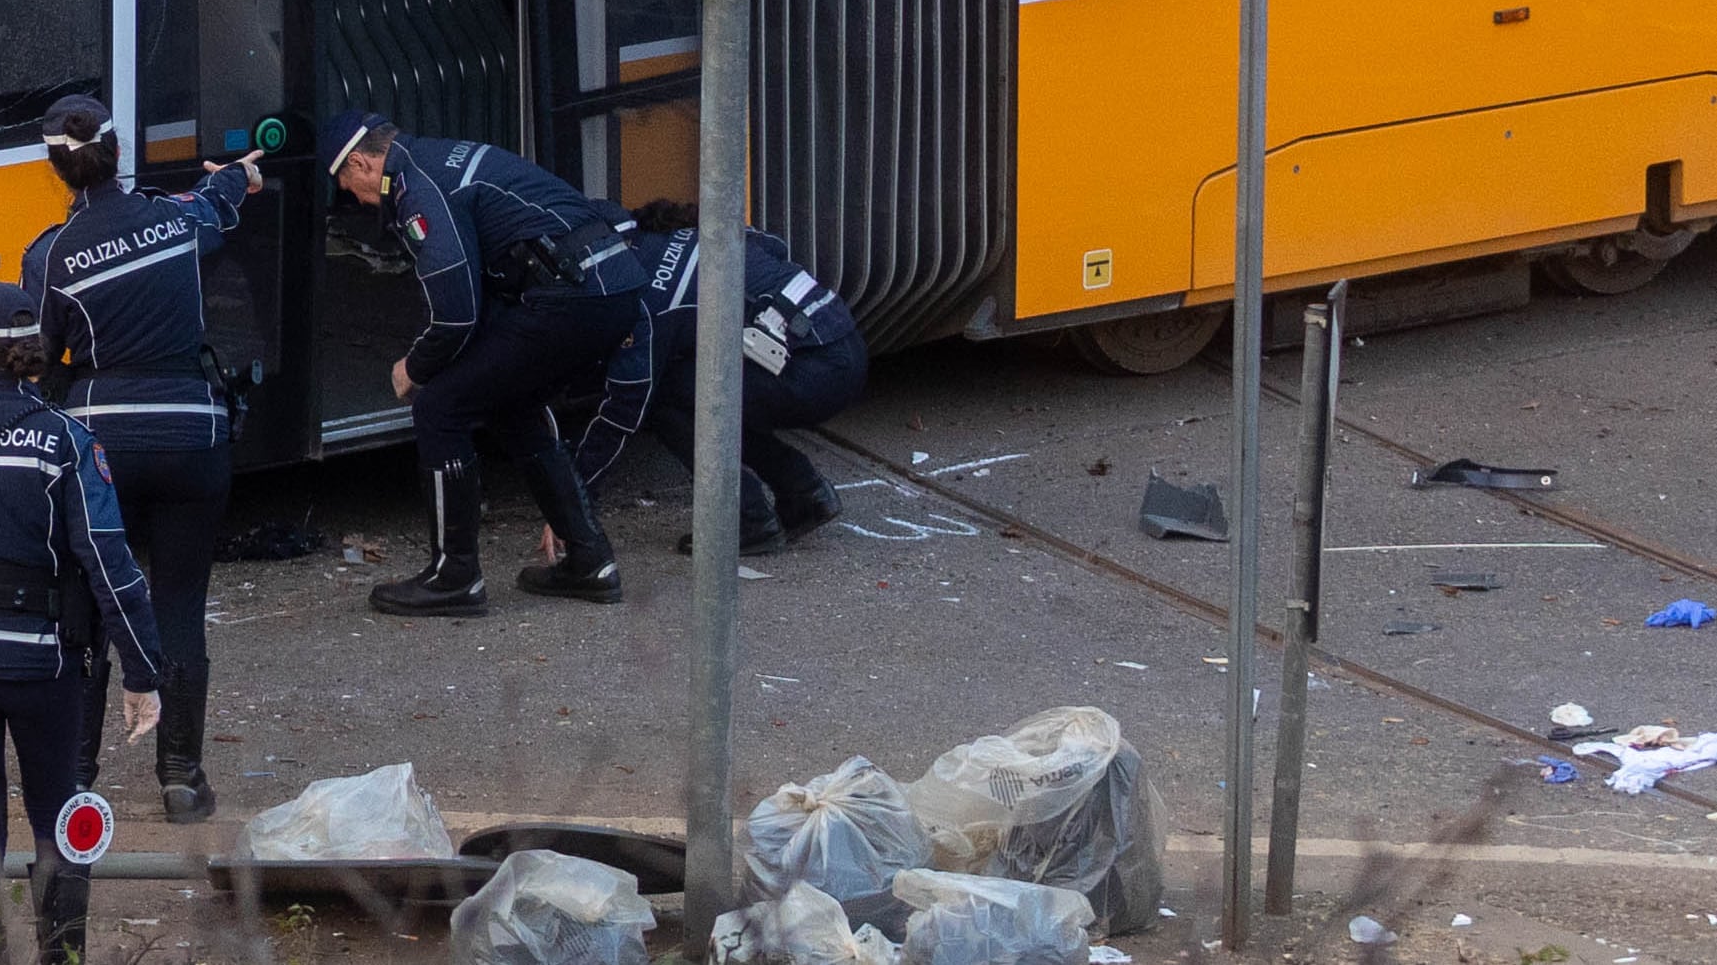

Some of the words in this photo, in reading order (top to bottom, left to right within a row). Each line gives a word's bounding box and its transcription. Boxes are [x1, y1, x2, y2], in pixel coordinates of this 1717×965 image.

[64, 237, 132, 275] POLIZIA
[133, 217, 189, 249] LOCALE
[651, 241, 687, 291] POLIZIA
[60, 799, 80, 835] COMUNE
[84, 796, 93, 804] DI
